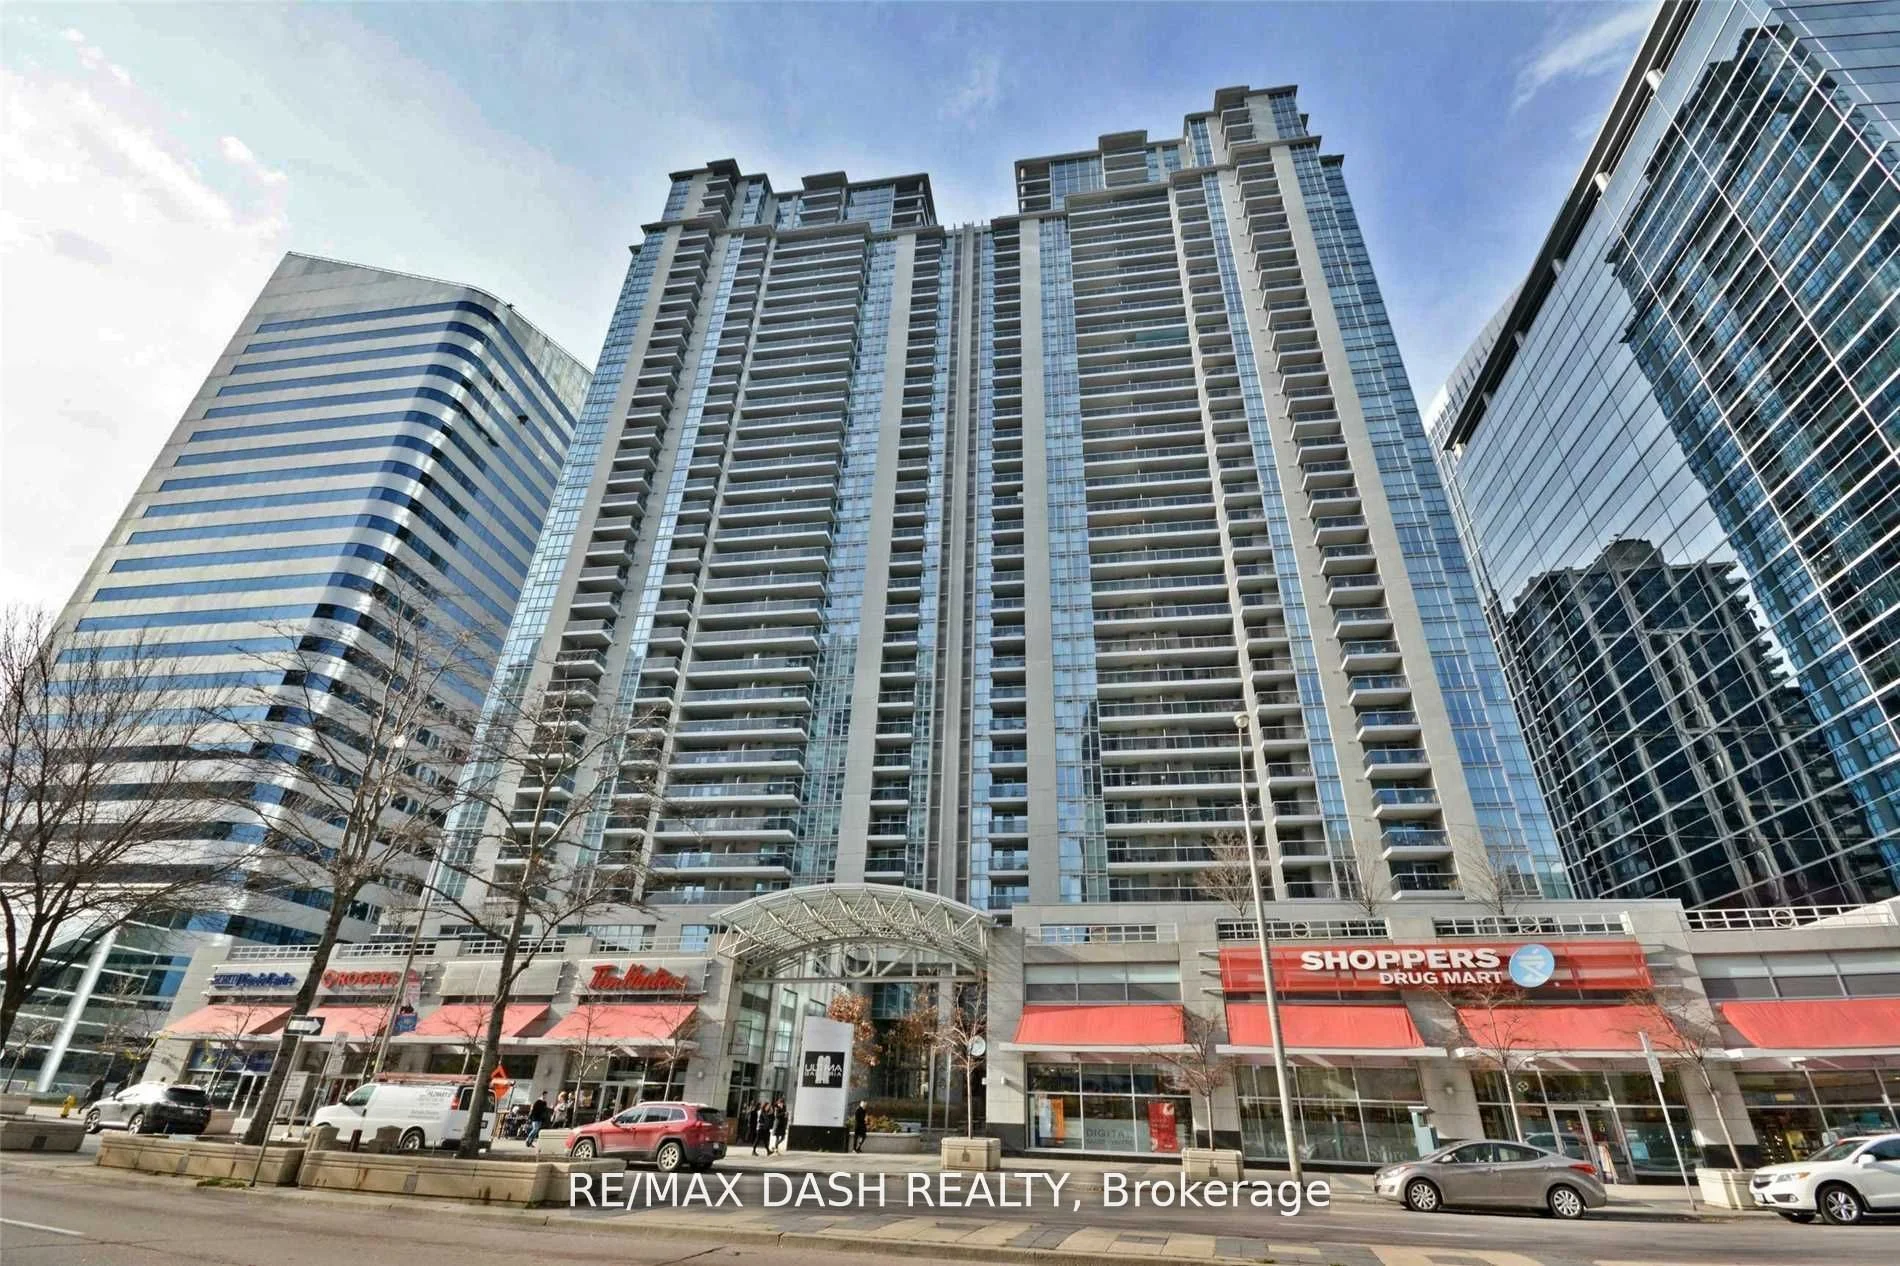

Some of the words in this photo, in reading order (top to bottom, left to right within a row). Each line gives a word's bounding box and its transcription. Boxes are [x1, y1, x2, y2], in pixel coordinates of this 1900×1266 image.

[1301, 948, 1500, 970] SHOPPERS
[338, 970, 400, 986] ROGERS
[1379, 971, 1439, 985] DRUG
[1441, 971, 1503, 984] MART
[805, 1063, 842, 1072] ULMA
